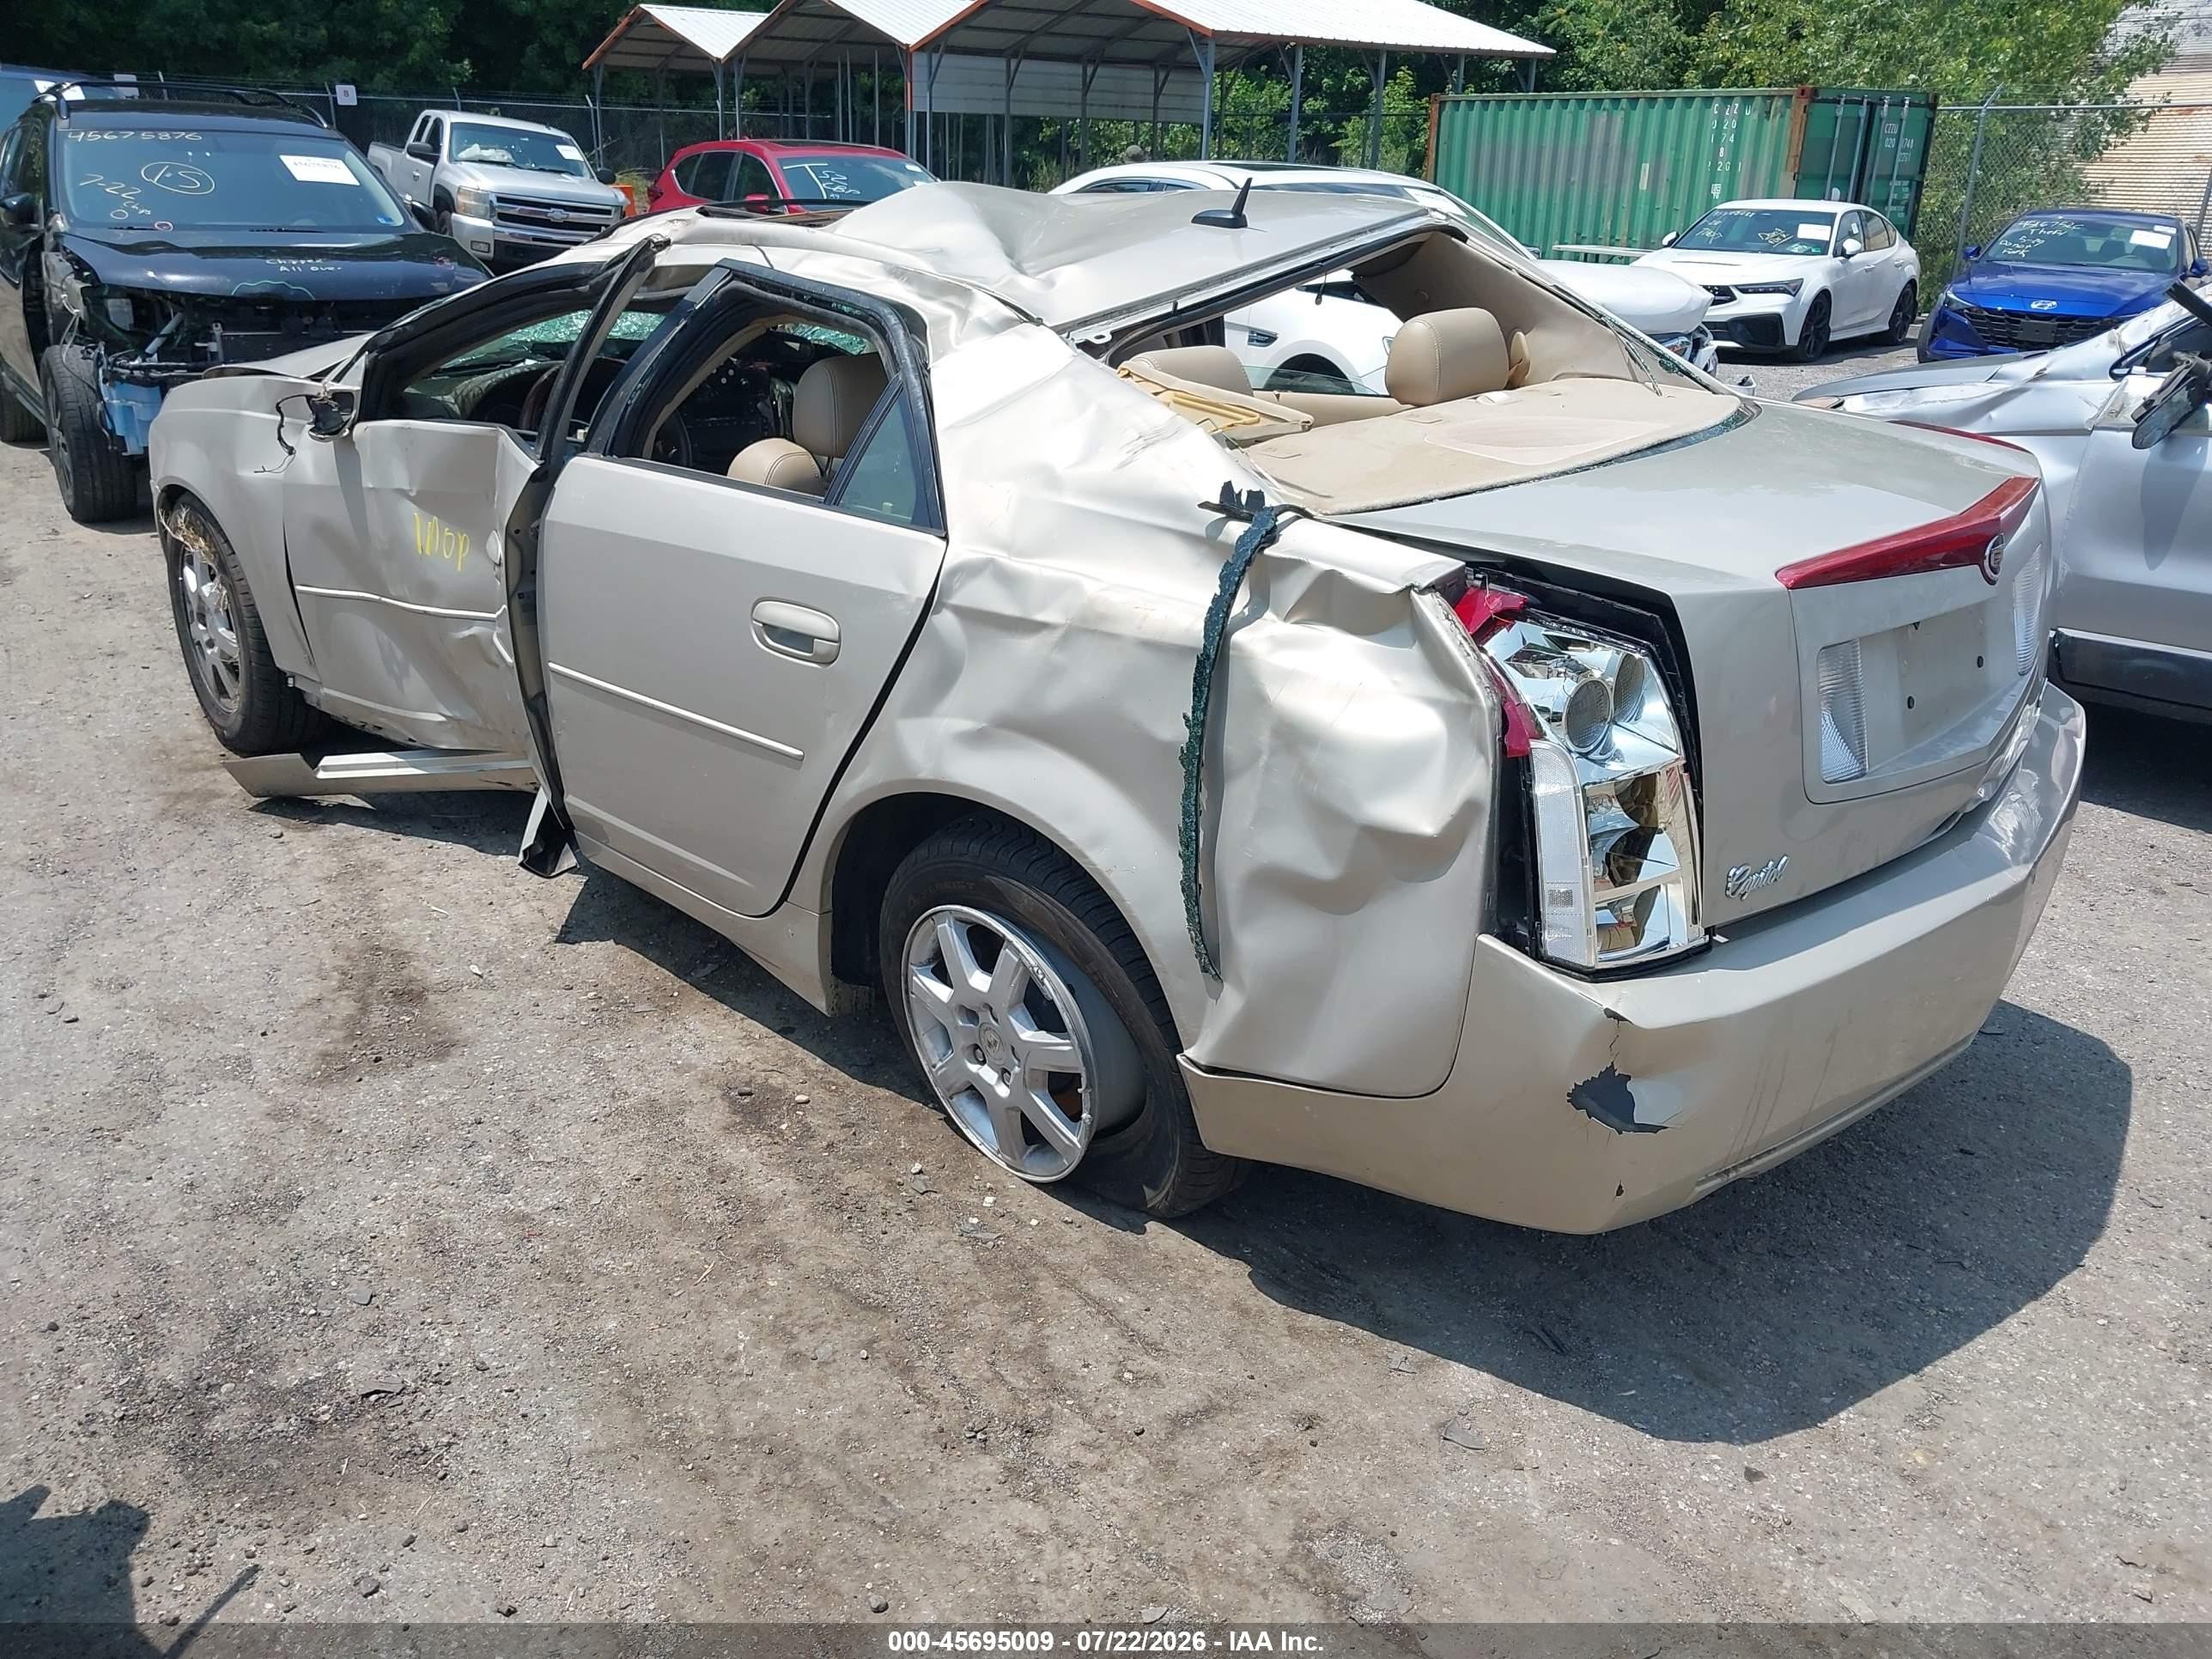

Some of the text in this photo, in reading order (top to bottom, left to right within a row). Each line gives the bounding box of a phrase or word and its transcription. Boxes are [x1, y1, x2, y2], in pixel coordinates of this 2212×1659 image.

[1713, 103, 1751, 116] CZZU
[68, 131, 203, 143] 45675876
[1719, 147, 1724, 157] 8
[79, 173, 143, 200] 7-22
